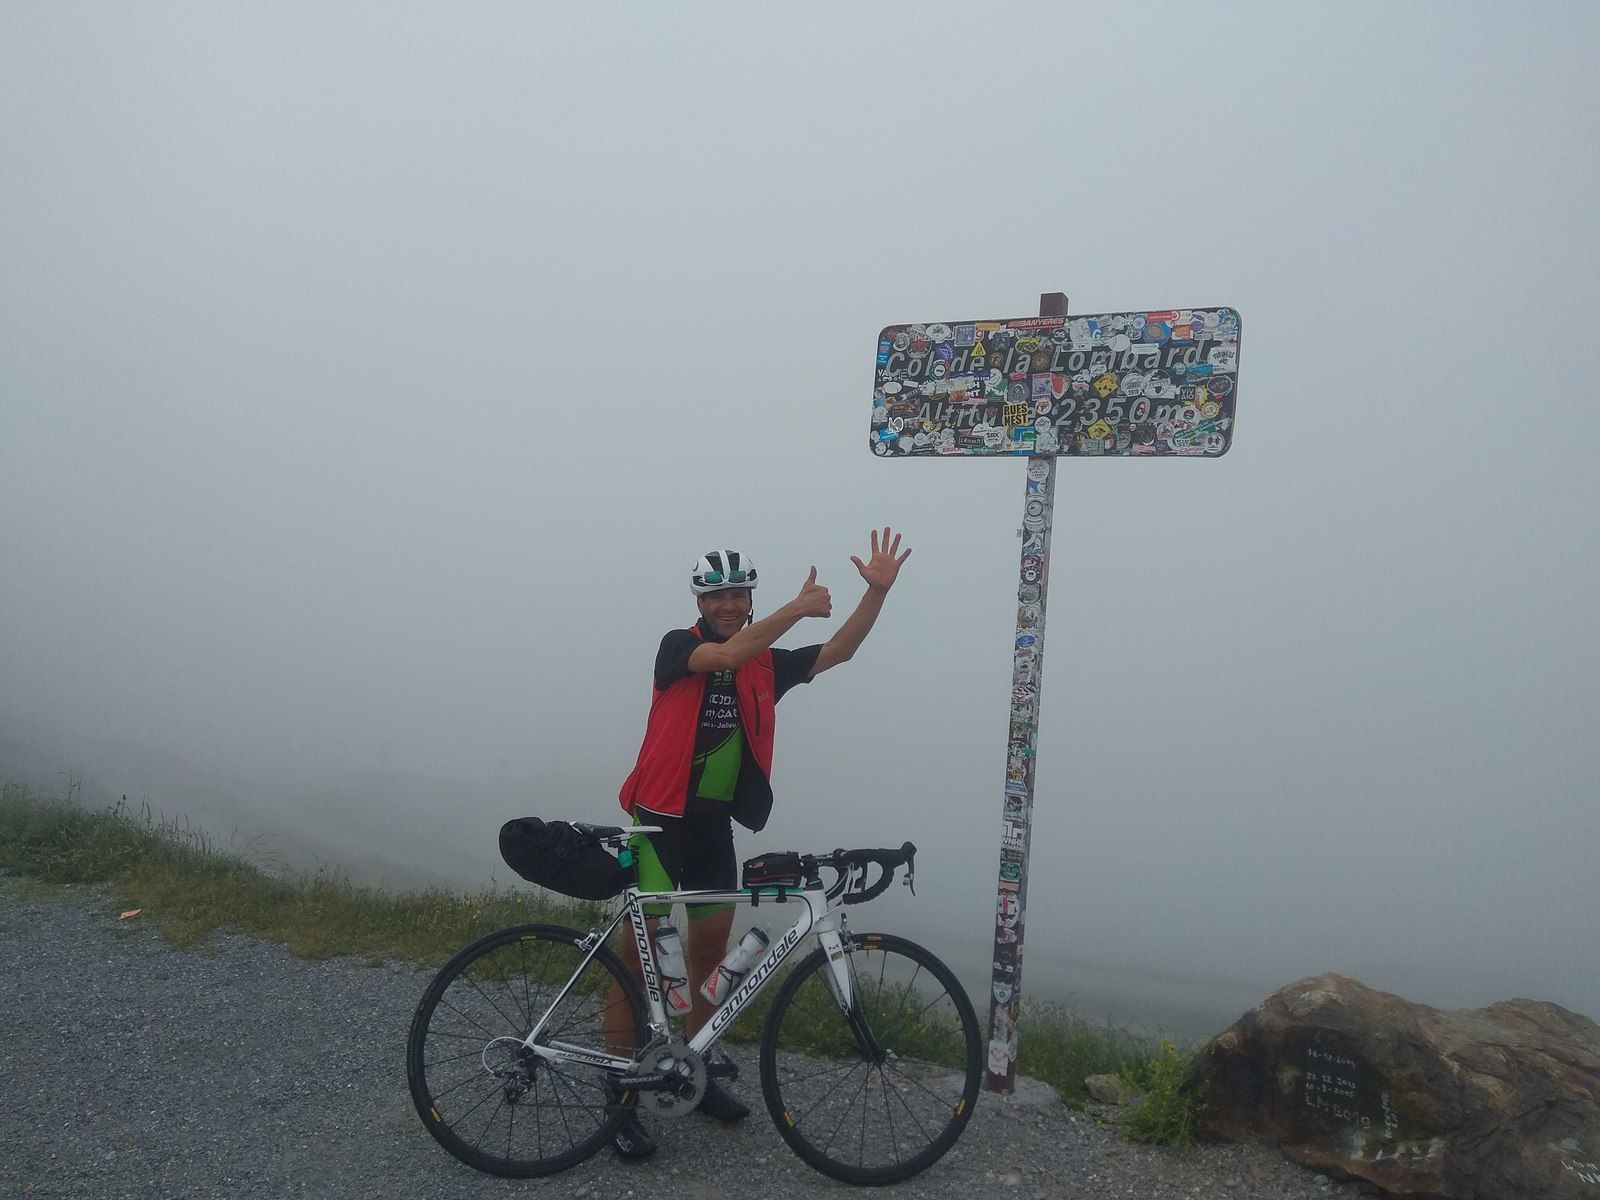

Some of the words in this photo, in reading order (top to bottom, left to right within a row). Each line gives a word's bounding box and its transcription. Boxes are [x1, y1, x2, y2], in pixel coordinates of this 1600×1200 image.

[886, 350, 935, 377] Col
[951, 349, 985, 372] de
[1003, 347, 1031, 373] la
[1049, 339, 1207, 372] Lombard
[627, 892, 660, 1003] cannondale
[711, 929, 799, 1032] cannondale
